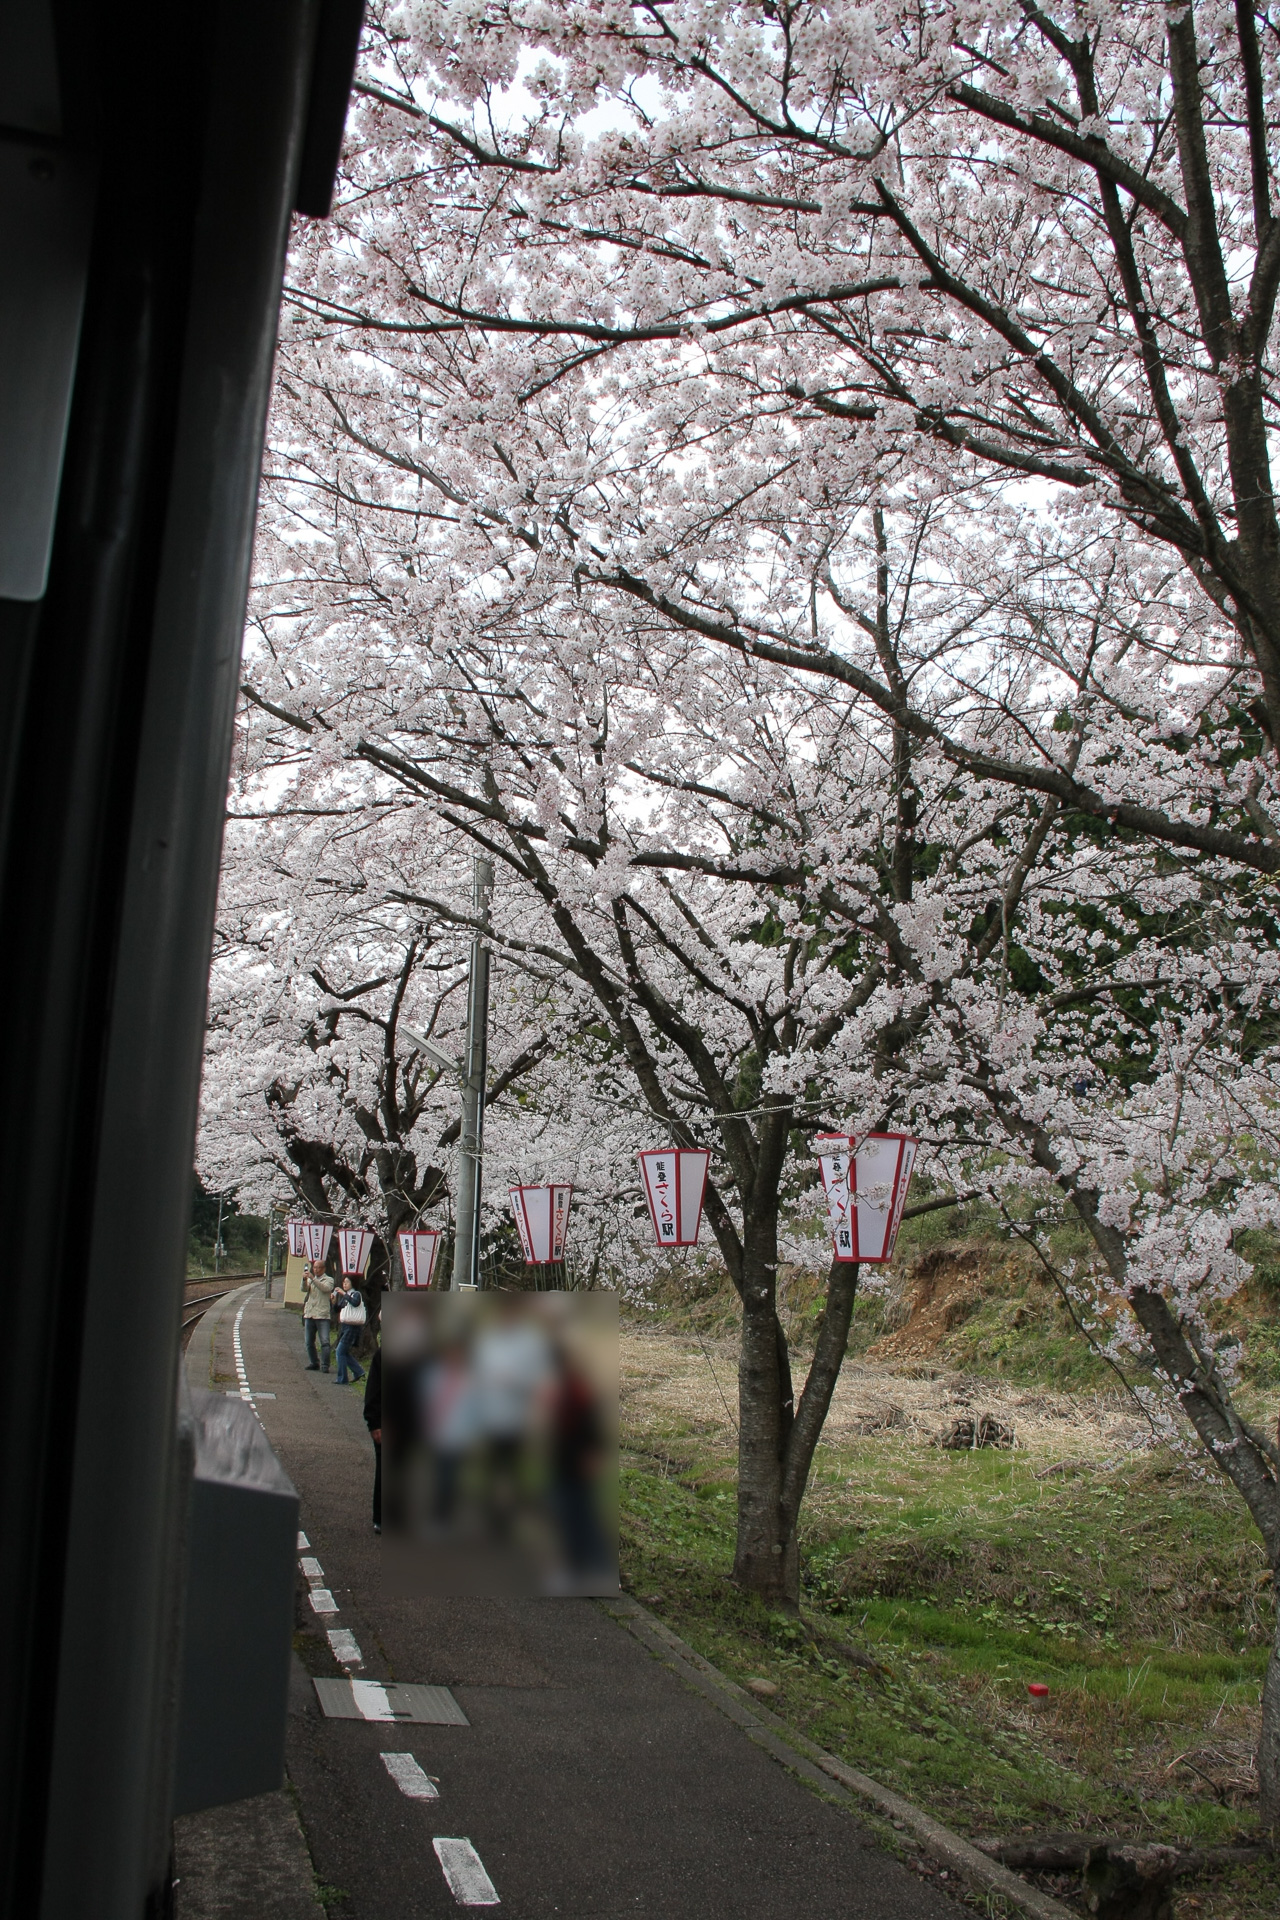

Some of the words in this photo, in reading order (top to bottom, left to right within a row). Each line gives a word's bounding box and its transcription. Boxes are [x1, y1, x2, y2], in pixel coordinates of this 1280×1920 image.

[554, 1193, 565, 1256] 能登さくら駅
[655, 1161, 674, 1236] 能登さくら駅
